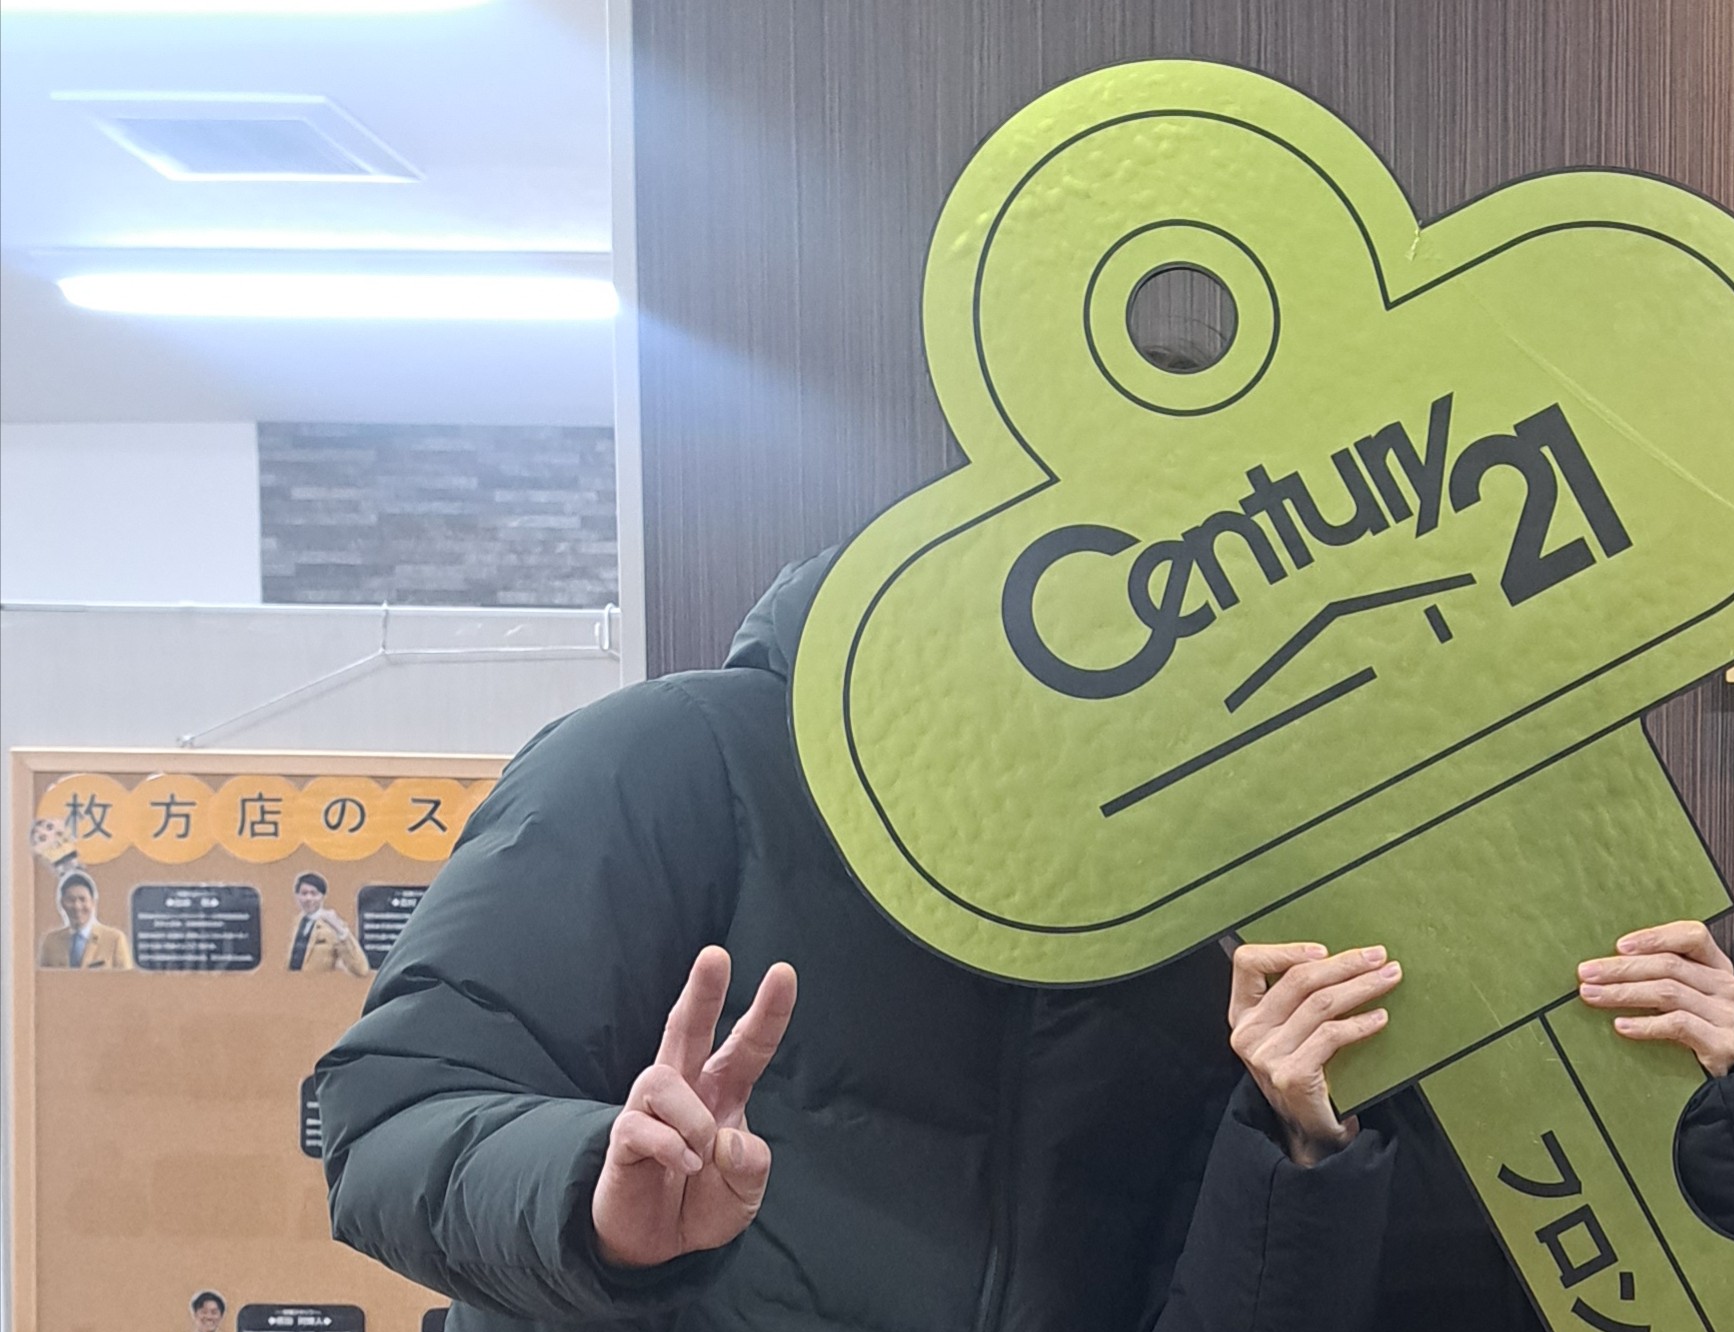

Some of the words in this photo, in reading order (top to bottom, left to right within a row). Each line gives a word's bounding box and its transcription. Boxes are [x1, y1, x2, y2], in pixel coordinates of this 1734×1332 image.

[1001, 392, 1453, 700] Century
[1449, 403, 1633, 607] 21
[65, 791, 449, 840] 枚方店のス
